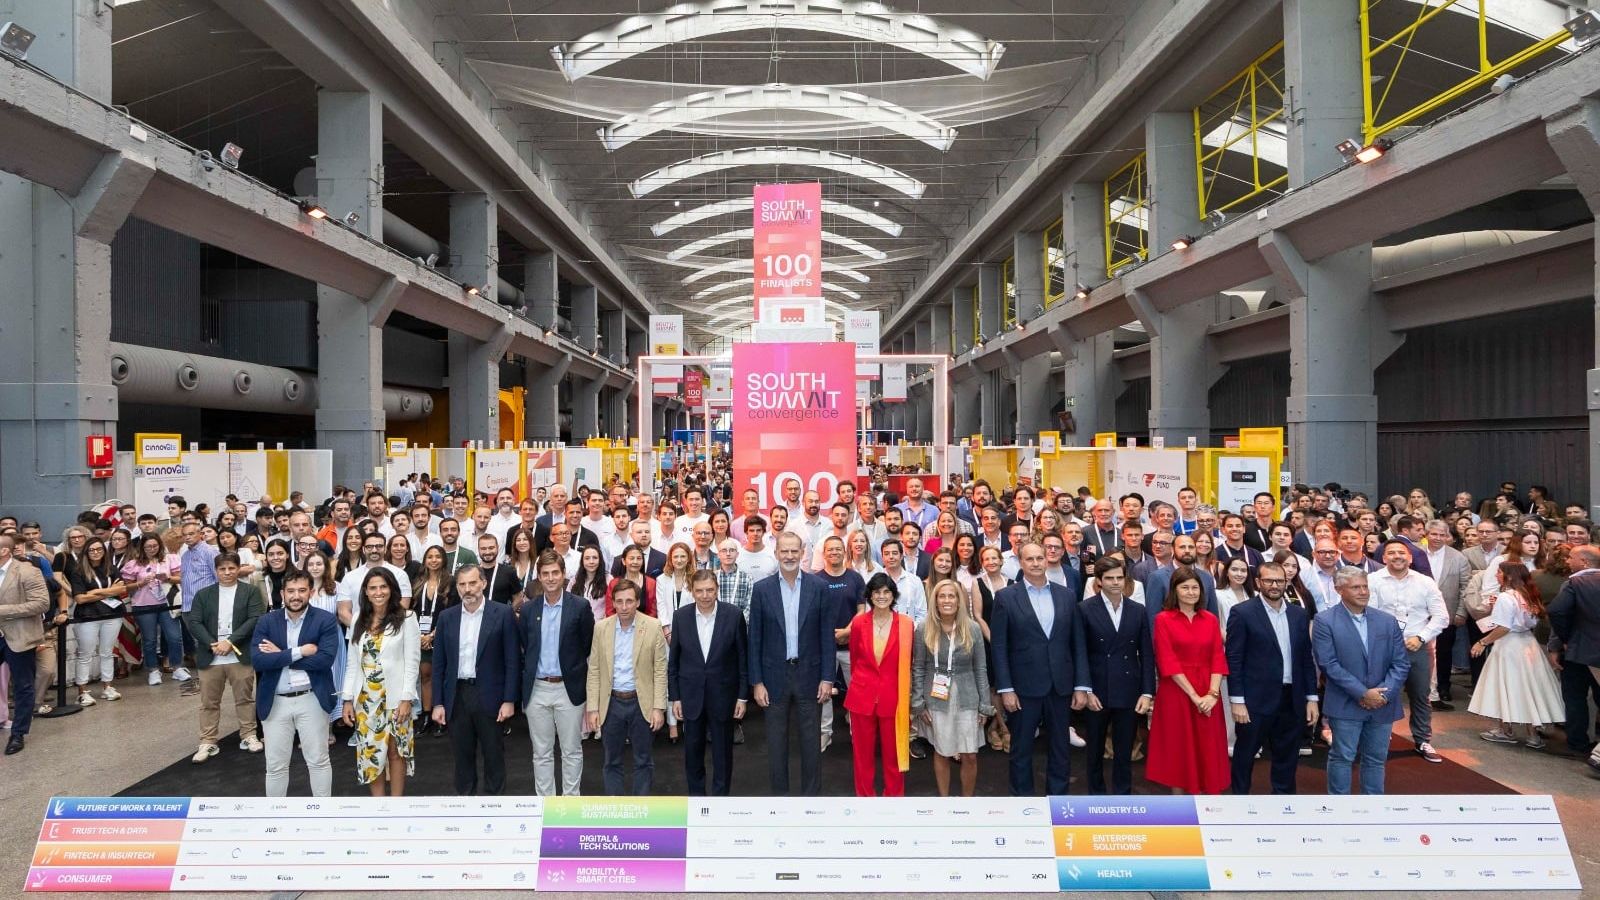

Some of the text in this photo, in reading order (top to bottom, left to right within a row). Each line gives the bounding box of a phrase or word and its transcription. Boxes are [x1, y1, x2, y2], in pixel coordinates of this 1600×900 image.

[761, 200, 805, 211] SOUTH
[761, 210, 813, 221] SUMMIT
[763, 254, 812, 277] 100
[760, 279, 813, 288] FINALISTS
[747, 372, 826, 391] SOUTH
[747, 391, 841, 409] SUMMIT
[748, 409, 839, 421] convergence
[1280, 475, 1290, 483] 82
[750, 471, 840, 510] 100
[77, 804, 107, 812] FUTURE
[1088, 806, 1146, 814] INDUSTRY 5.0
[71, 827, 99, 835] TRUST
[1092, 834, 1147, 842] ENTERPRISE
[1093, 843, 1142, 851] SOLUTIONS
[63, 851, 99, 860] FINTECH
[107, 851, 155, 860] INSURTECH
[577, 867, 618, 876] MOBILITY
[1097, 870, 1133, 878] HEALTH
[57, 874, 113, 884] CONSUMER
[576, 876, 607, 884] SMART
